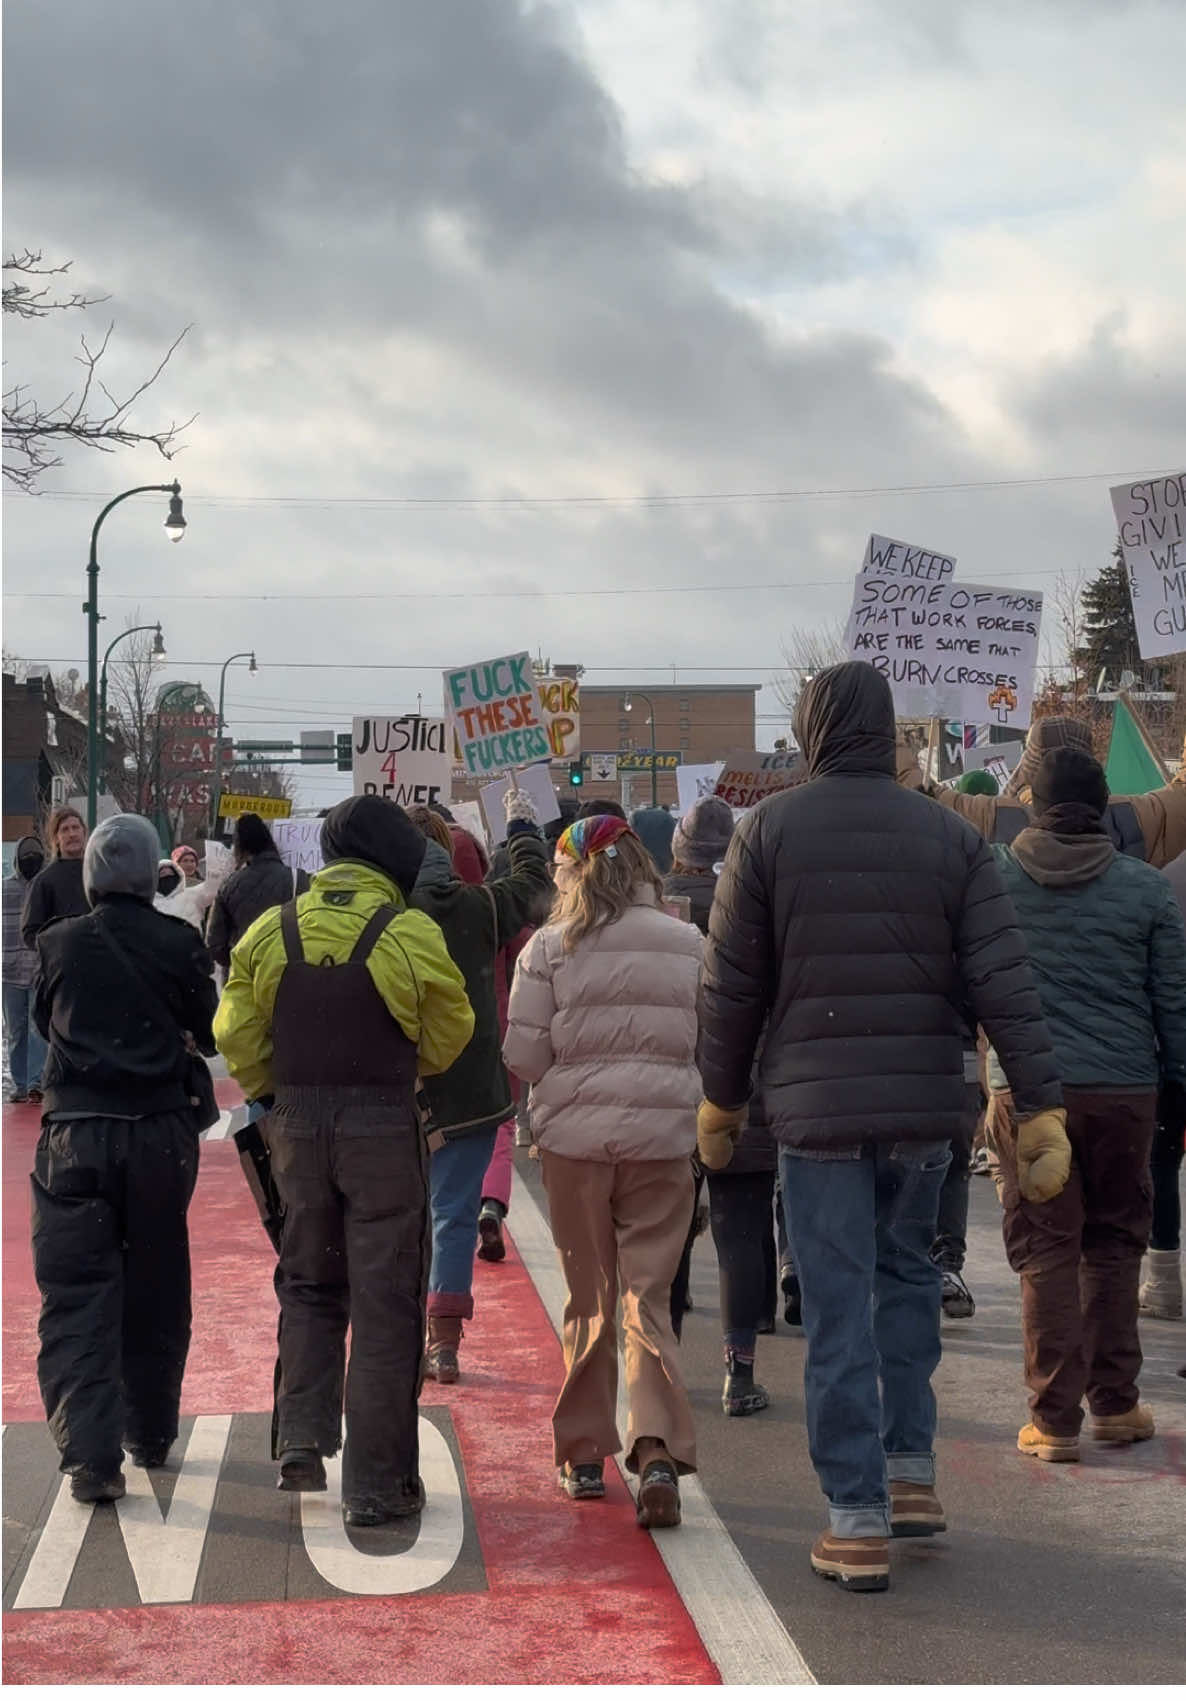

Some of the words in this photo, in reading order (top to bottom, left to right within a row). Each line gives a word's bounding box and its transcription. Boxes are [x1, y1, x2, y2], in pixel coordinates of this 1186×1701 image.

[870, 536, 902, 572] WE
[901, 547, 953, 581] KEEP
[861, 580, 945, 608] SOME
[951, 590, 993, 609] OF
[997, 594, 1043, 612] THOSE
[855, 606, 907, 627] THAT
[911, 609, 967, 628] WORK
[977, 616, 1037, 637] FORCES,
[854, 632, 889, 651] ARE
[896, 634, 924, 650] THE
[936, 638, 980, 654] SAME
[988, 644, 1022, 657] THAT
[449, 657, 532, 708] FUCK
[872, 655, 941, 685] BURN
[944, 667, 1018, 689] CROSSES
[457, 694, 538, 739] THESE
[464, 727, 549, 772] FUCKERS
[761, 753, 799, 770] ICE
[380, 752, 398, 783] 4
